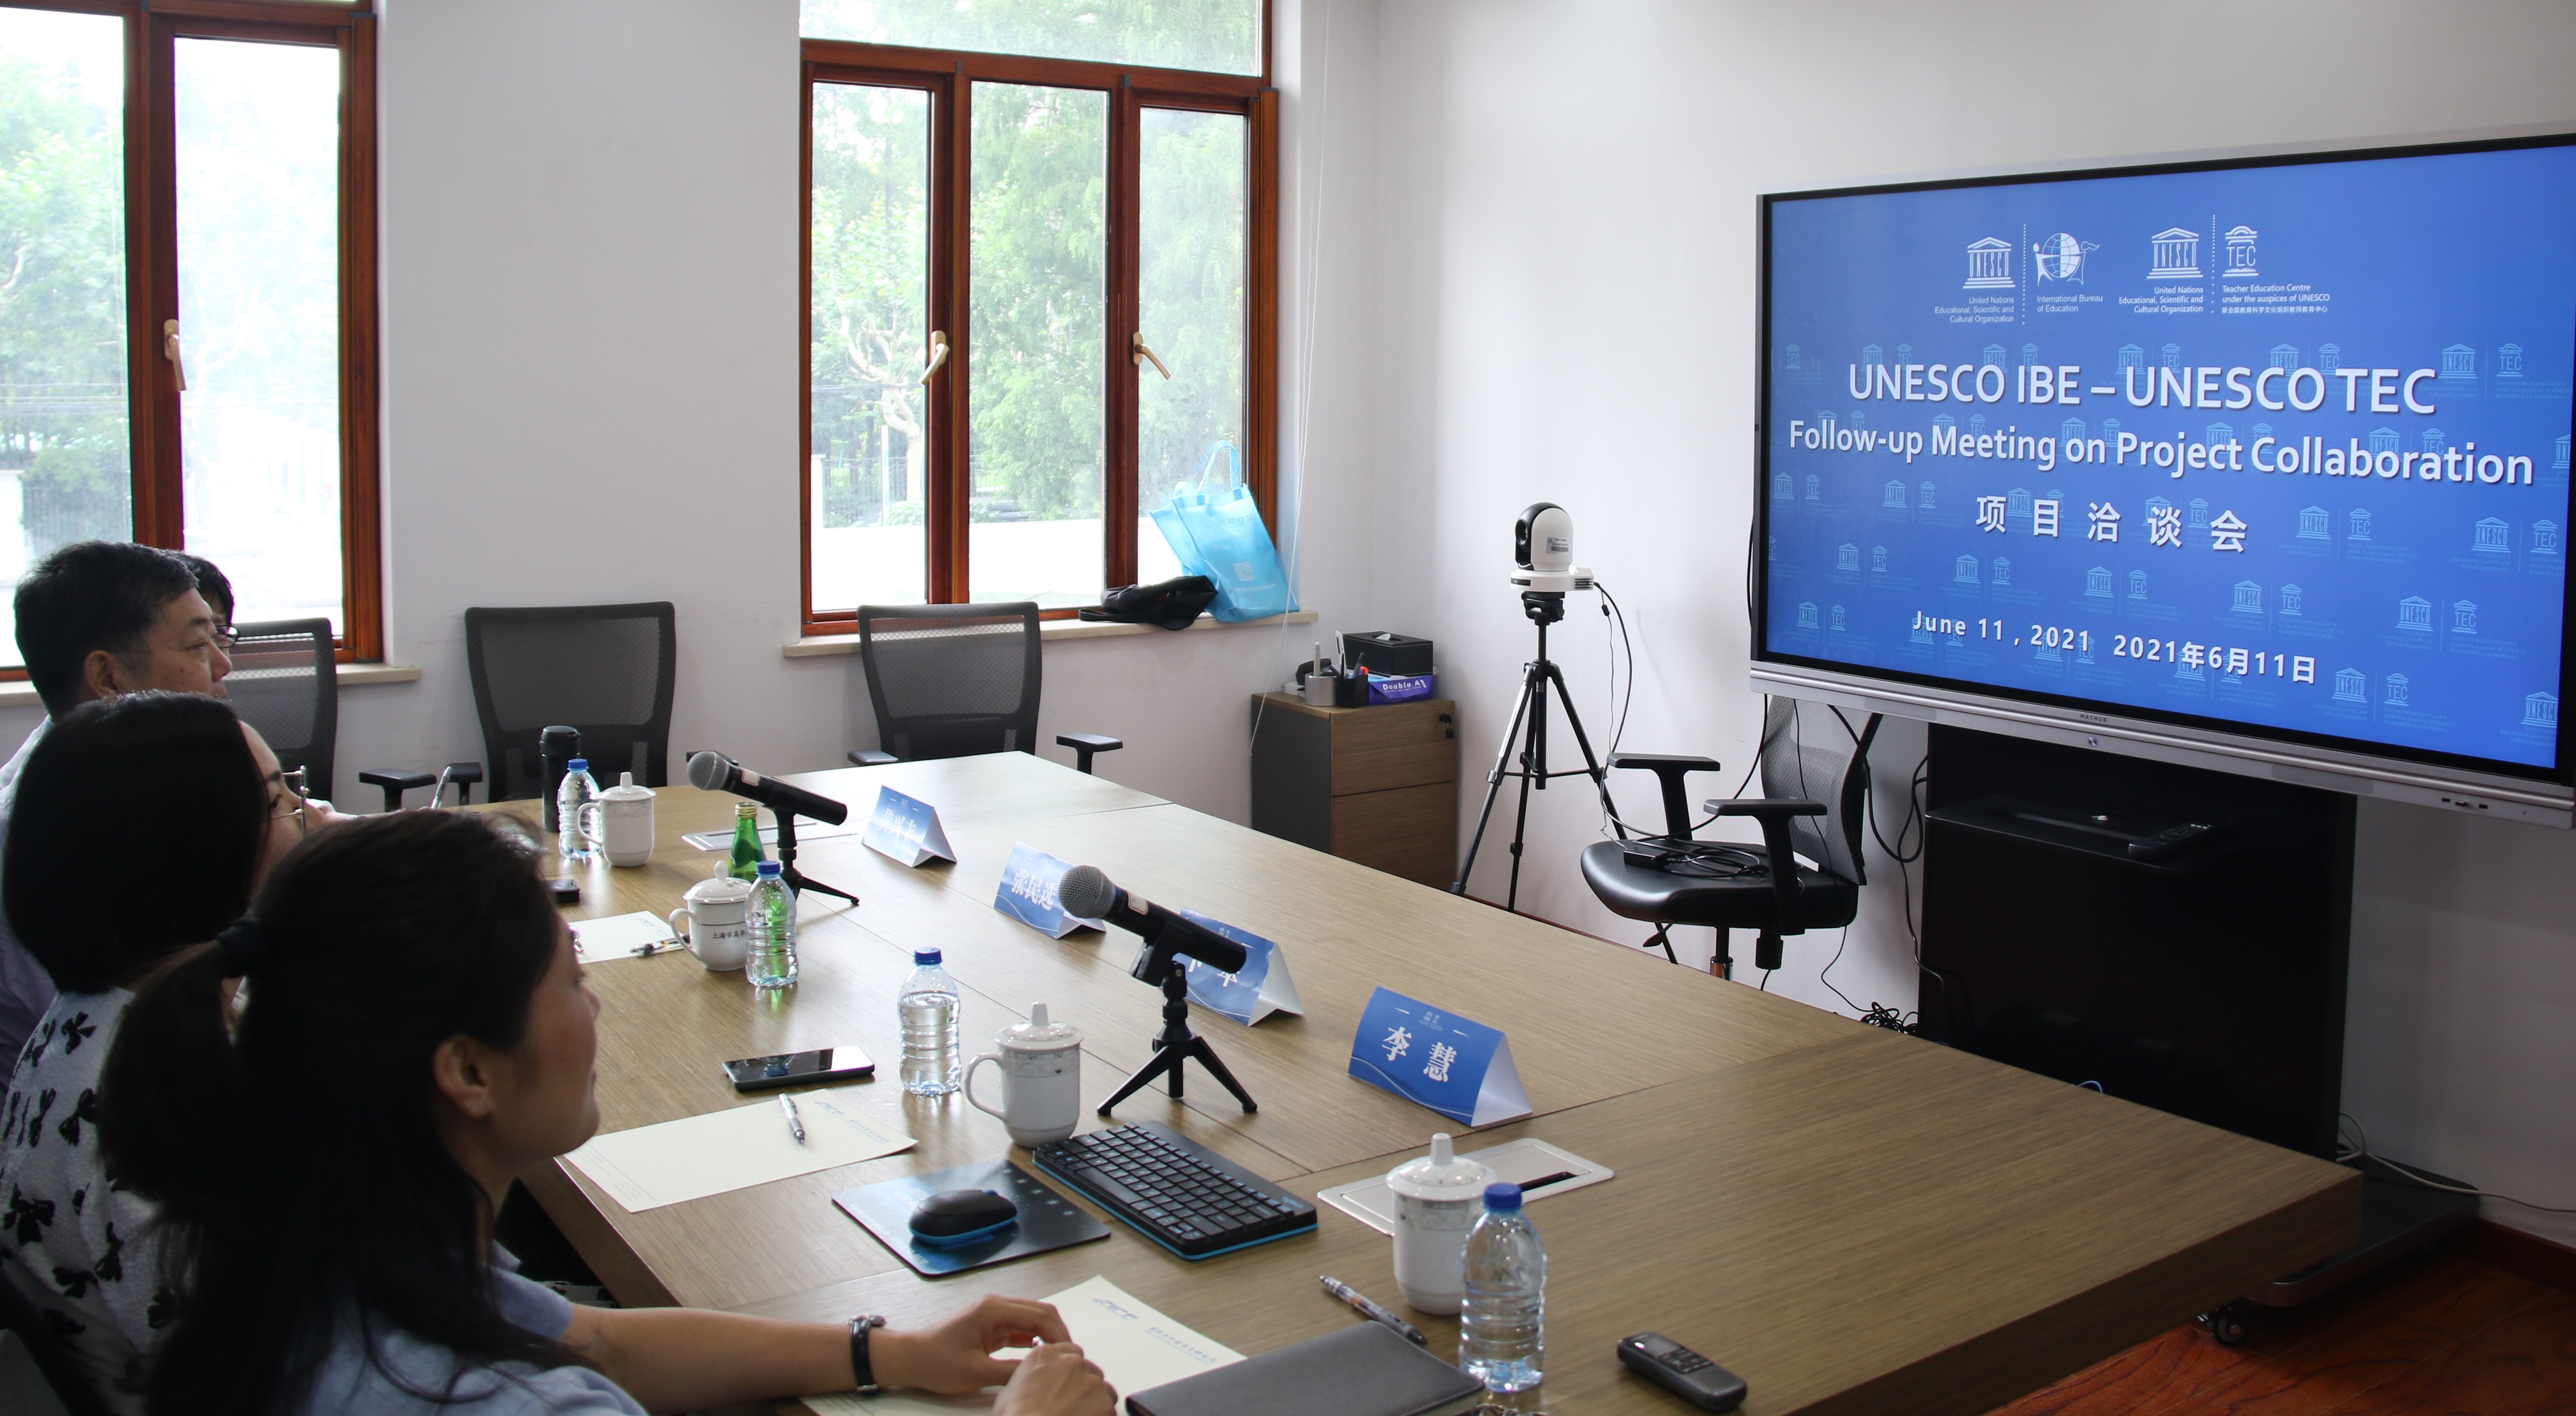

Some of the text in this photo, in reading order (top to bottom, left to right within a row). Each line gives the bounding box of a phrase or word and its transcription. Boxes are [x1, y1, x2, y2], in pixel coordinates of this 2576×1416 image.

[2153, 242, 2197, 268] UNESCO
[2226, 245, 2257, 267] TEC
[1969, 251, 2010, 278] UNESCO
[2178, 286, 2204, 294] Nations
[2222, 285, 2249, 293] Teacher
[2037, 294, 2103, 303] International Bureau
[2118, 295, 2203, 305] Educational, Scientific and
[2257, 295, 2288, 304] auspices
[2298, 293, 2330, 302] UNESCO
[2045, 304, 2079, 313] Education
[2160, 305, 2203, 314] Organization
[1975, 314, 2014, 324] Organization
[2443, 354, 2474, 371] UNESCO
[2500, 356, 2522, 371] TEC
[1849, 363, 2006, 404] UNESCO
[2018, 365, 2081, 404] IBE
[2126, 366, 2326, 411] UNESCO
[2335, 368, 2436, 414] TEC
[1789, 419, 2533, 485] Follow-up Meeting on Project Collaboration
[1975, 494, 2248, 553] 项目洽谈会
[2350, 520, 2370, 534] TEC
[2476, 526, 2508, 545] UNESCO
[2533, 532, 2557, 548] TEC
[2400, 605, 2431, 623] UNESCO
[2454, 611, 2476, 627] TEC
[1912, 609, 1967, 636] June
[1978, 618, 2003, 641] 11
[2030, 624, 2090, 652] 2021
[2113, 634, 2316, 685] 2021年6月11日
[1382, 681, 1411, 690] Double
[1414, 679, 1427, 688] A
[2335, 676, 2364, 695] UNESCO
[2387, 684, 2408, 700] TEC
[2080, 713, 2108, 723] MAXHUB
[1010, 867, 1057, 911] 张民选
[1381, 1026, 1457, 1083] 李慧
